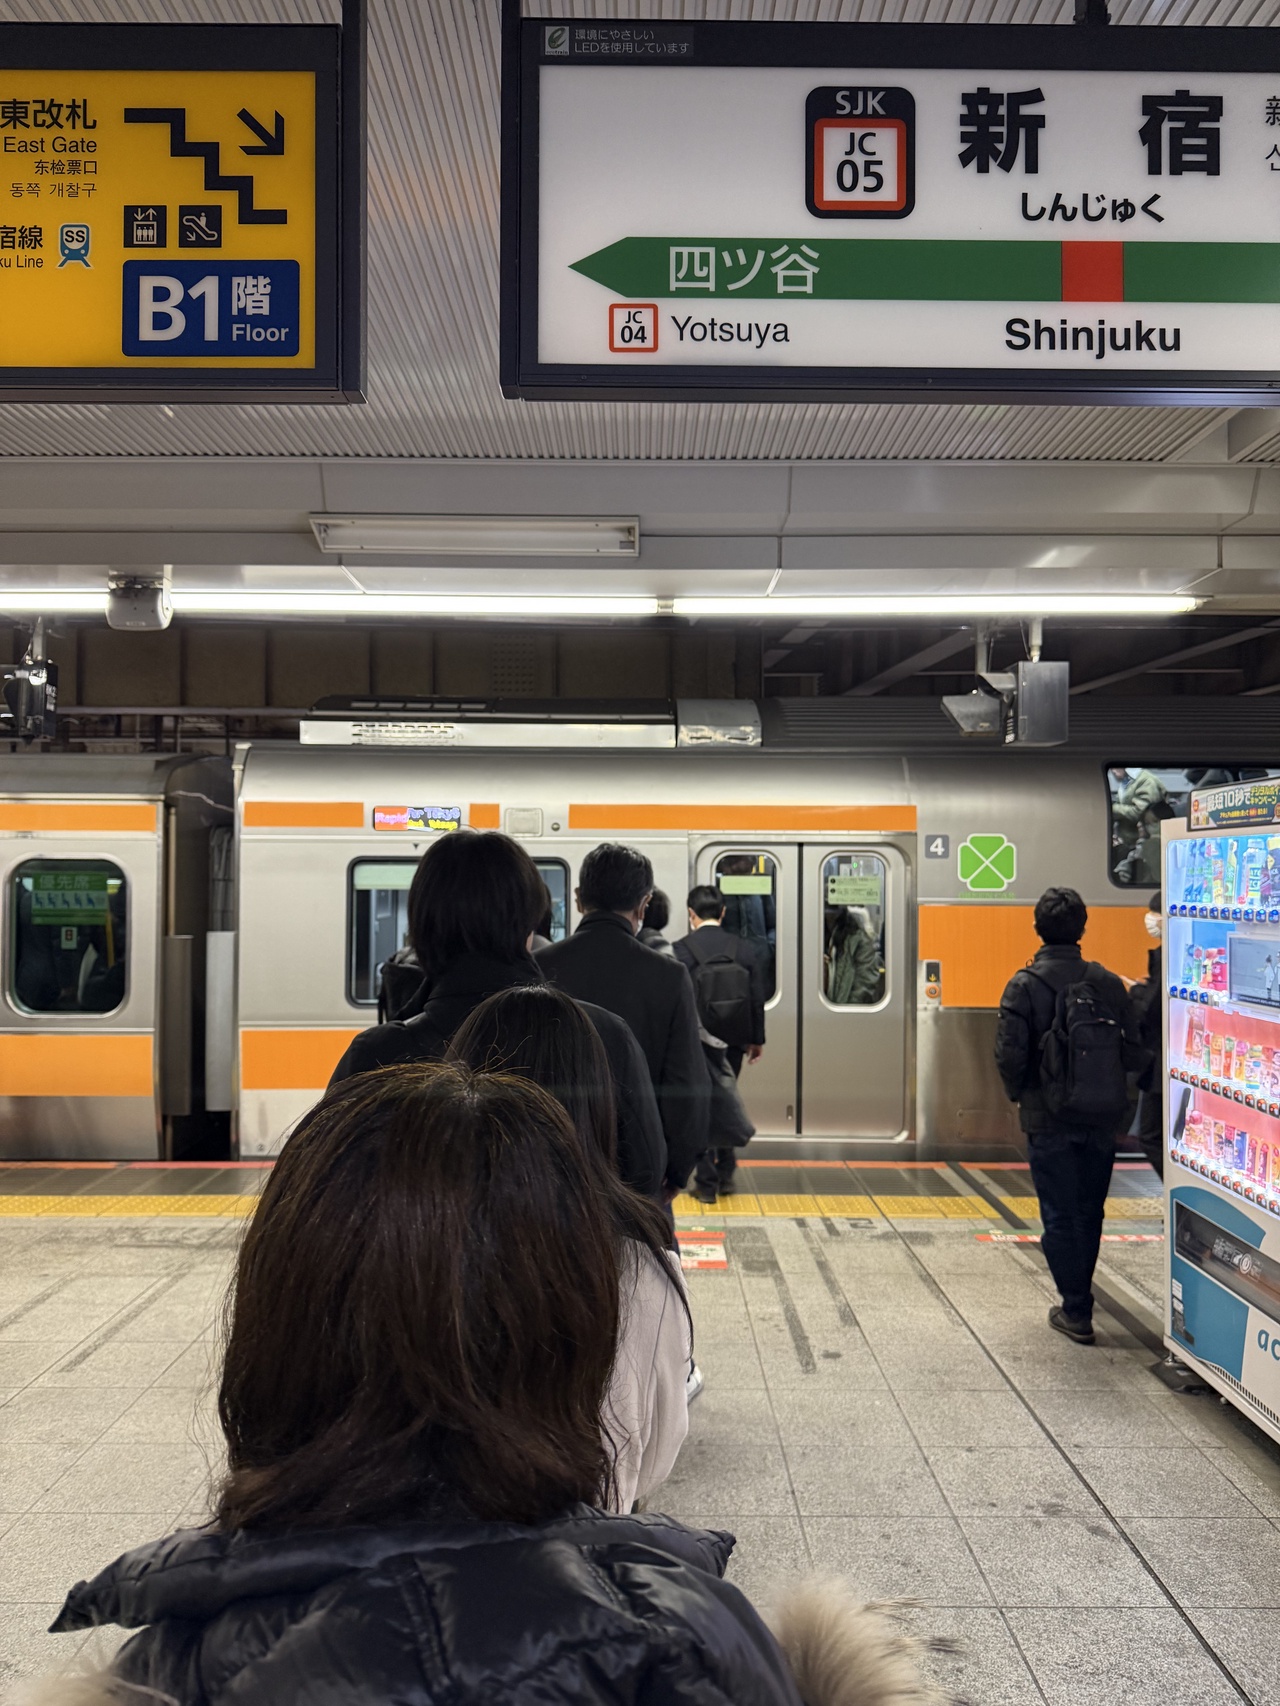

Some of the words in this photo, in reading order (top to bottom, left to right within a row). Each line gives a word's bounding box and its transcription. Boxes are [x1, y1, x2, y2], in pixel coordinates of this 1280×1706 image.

[575, 29, 655, 41] 環境にやさしい
[574, 42, 690, 54] LEDを使用しています
[835, 90, 887, 115] SJK
[0, 98, 97, 130] 東改札
[958, 87, 1223, 176] 新宿
[4, 136, 45, 153] East
[52, 136, 97, 153] Gate
[845, 132, 876, 156] JC
[34, 159, 97, 175] 东检票口
[836, 159, 884, 193] 05
[9, 182, 41, 198] 동쪽
[49, 182, 97, 198] 개찰구
[1021, 192, 1165, 223] しんじゅく
[64, 229, 86, 243] SS
[16, 255, 44, 268] Line
[669, 244, 820, 294] 四ツ谷
[624, 310, 643, 324] JC
[232, 323, 290, 342] Floor
[620, 325, 647, 344] 04
[671, 315, 790, 349] Yotsuya
[1005, 317, 1181, 360] Shinjuku
[929, 837, 945, 856] 4
